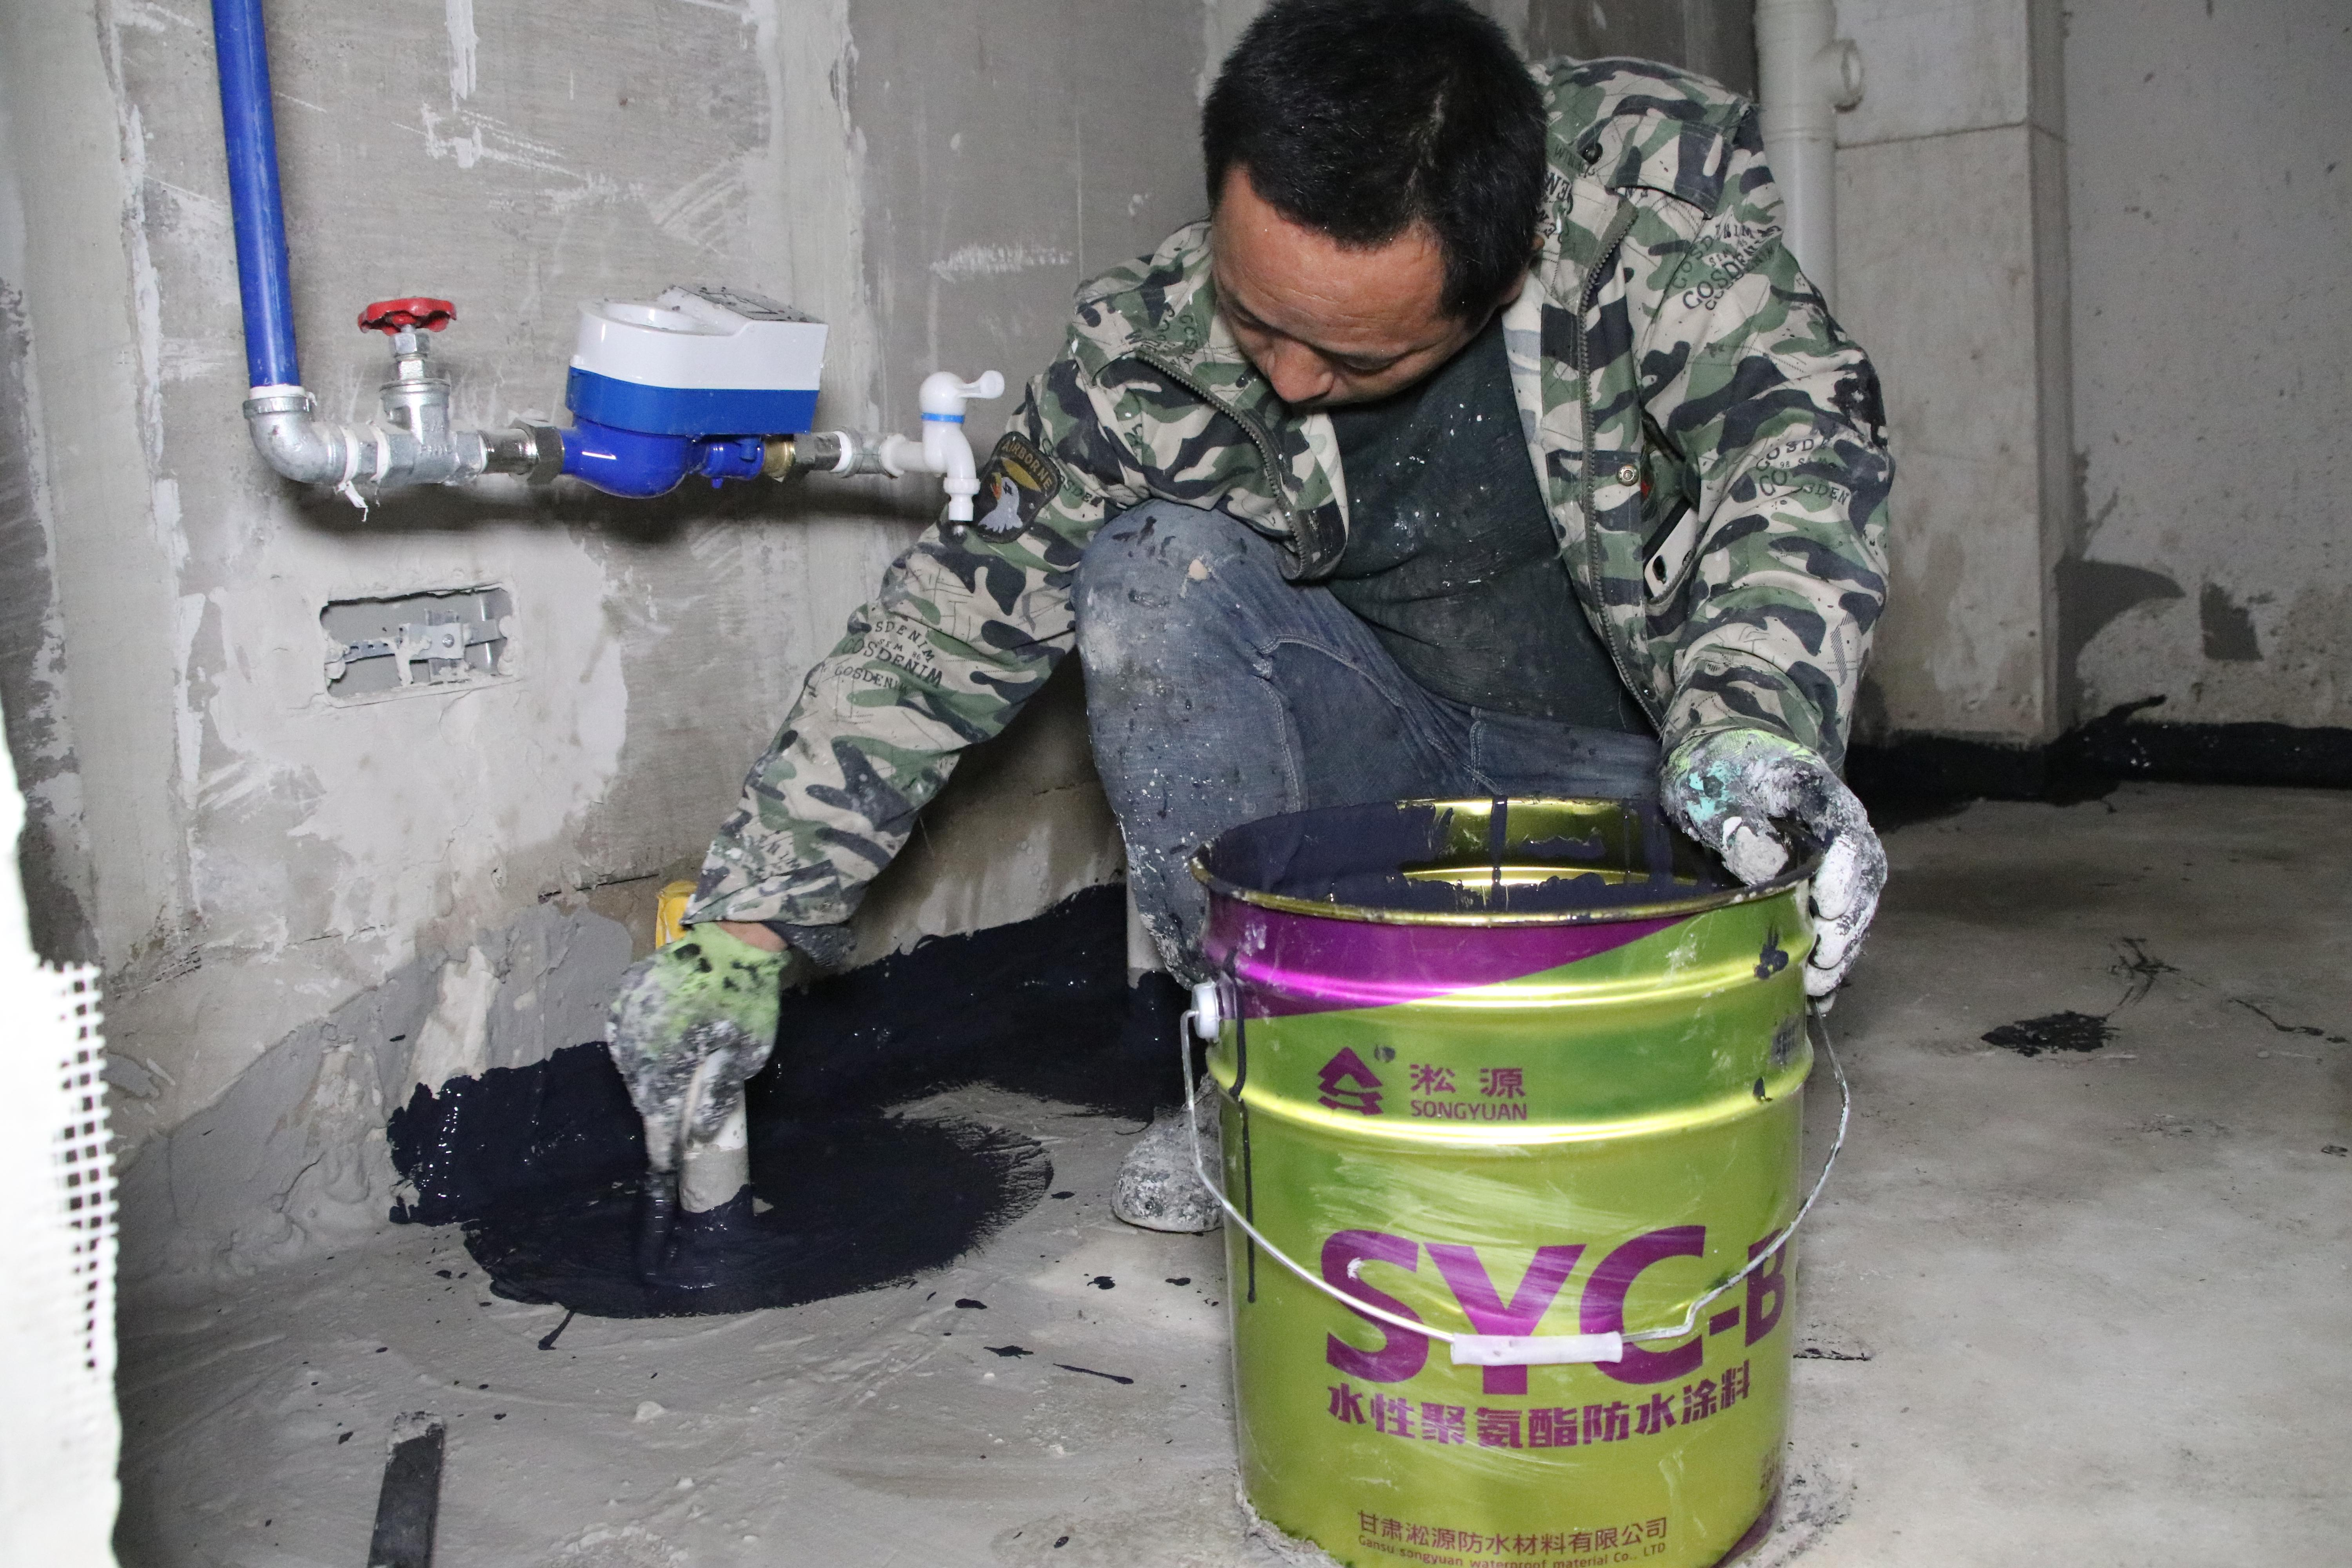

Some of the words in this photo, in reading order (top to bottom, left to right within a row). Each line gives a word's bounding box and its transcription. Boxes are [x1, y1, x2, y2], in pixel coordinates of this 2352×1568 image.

[1001, 441, 1053, 490] AIRBORNE
[1411, 1100, 1527, 1121] SONGYUAN
[1321, 1224, 1787, 1395] SYC-B
[1327, 1359, 1750, 1449] 水性聚氨酯防水涂料
[1357, 1509, 1667, 1555] 甘肃淞源防水材料有限公司
[1358, 1534, 1395, 1554] Gansu
[1399, 1548, 1463, 1565] songyuan
[1553, 1554, 1608, 1568] material
[1644, 1542, 1666, 1557] LTD
